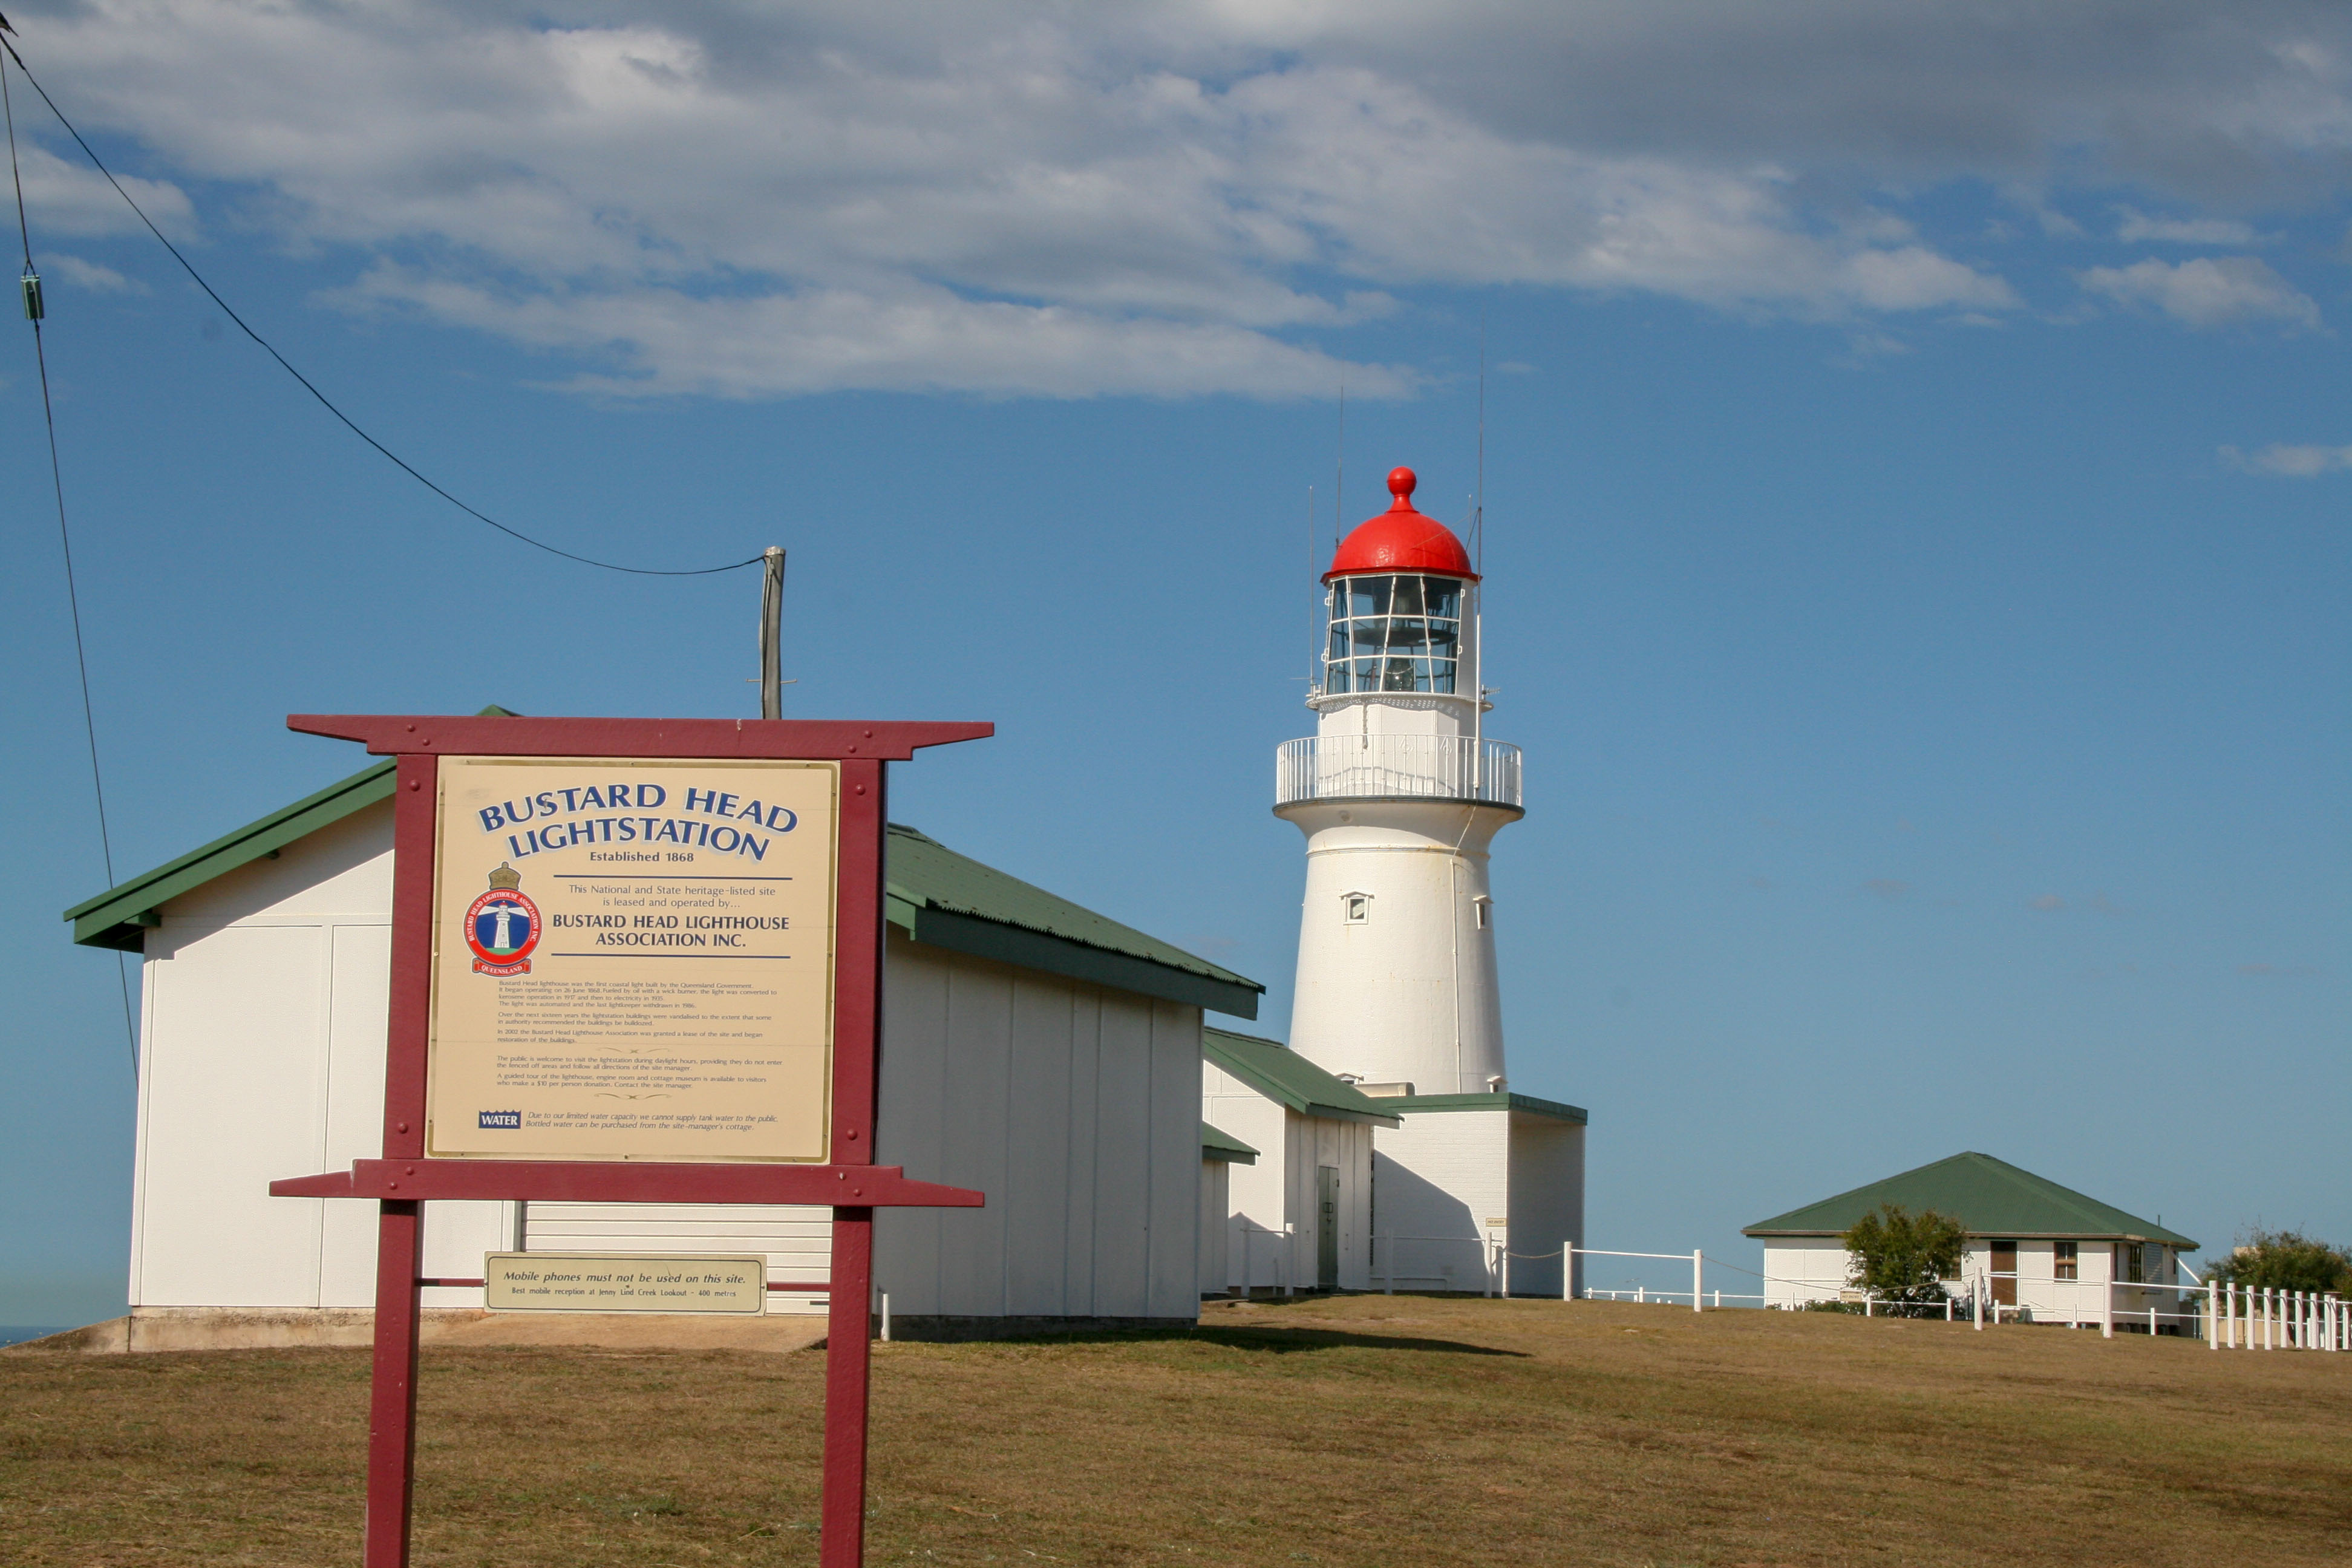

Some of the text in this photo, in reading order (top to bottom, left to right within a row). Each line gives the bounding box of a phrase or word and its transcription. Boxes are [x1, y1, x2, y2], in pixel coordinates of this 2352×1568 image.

[479, 785, 797, 832] BUSTARD HEAD
[509, 818, 767, 860] LIGHTSTATION
[590, 851, 694, 861] Established 1868
[569, 884, 587, 893] This
[591, 884, 630, 893] National
[635, 885, 653, 894] and
[656, 885, 681, 894] State
[685, 885, 755, 898] heritage-listed
[614, 897, 645, 906] leased
[648, 897, 667, 906] and
[670, 897, 714, 909] operated
[718, 898, 739, 909] by...
[467, 916, 475, 942] BUSTARD
[471, 901, 483, 915] HEAD
[483, 892, 518, 903] LIGHTHOUSE
[518, 897, 539, 929] ASSOCIATION
[553, 914, 789, 929] BUSTARD HEAD LIGHTHOUSE
[596, 932, 745, 947] ASSOCIATION INC.
[481, 965, 523, 974] QUEENSLAND
[482, 1115, 518, 1125] WATER
[676, 1114, 697, 1122] supply
[601, 1121, 638, 1130] purchased
[503, 1271, 539, 1281] Mobile
[543, 1272, 581, 1284] phones
[616, 1273, 633, 1282] not
[639, 1273, 652, 1282] be
[656, 1272, 681, 1282] used
[704, 1273, 721, 1282] this
[725, 1273, 745, 1283] site.
